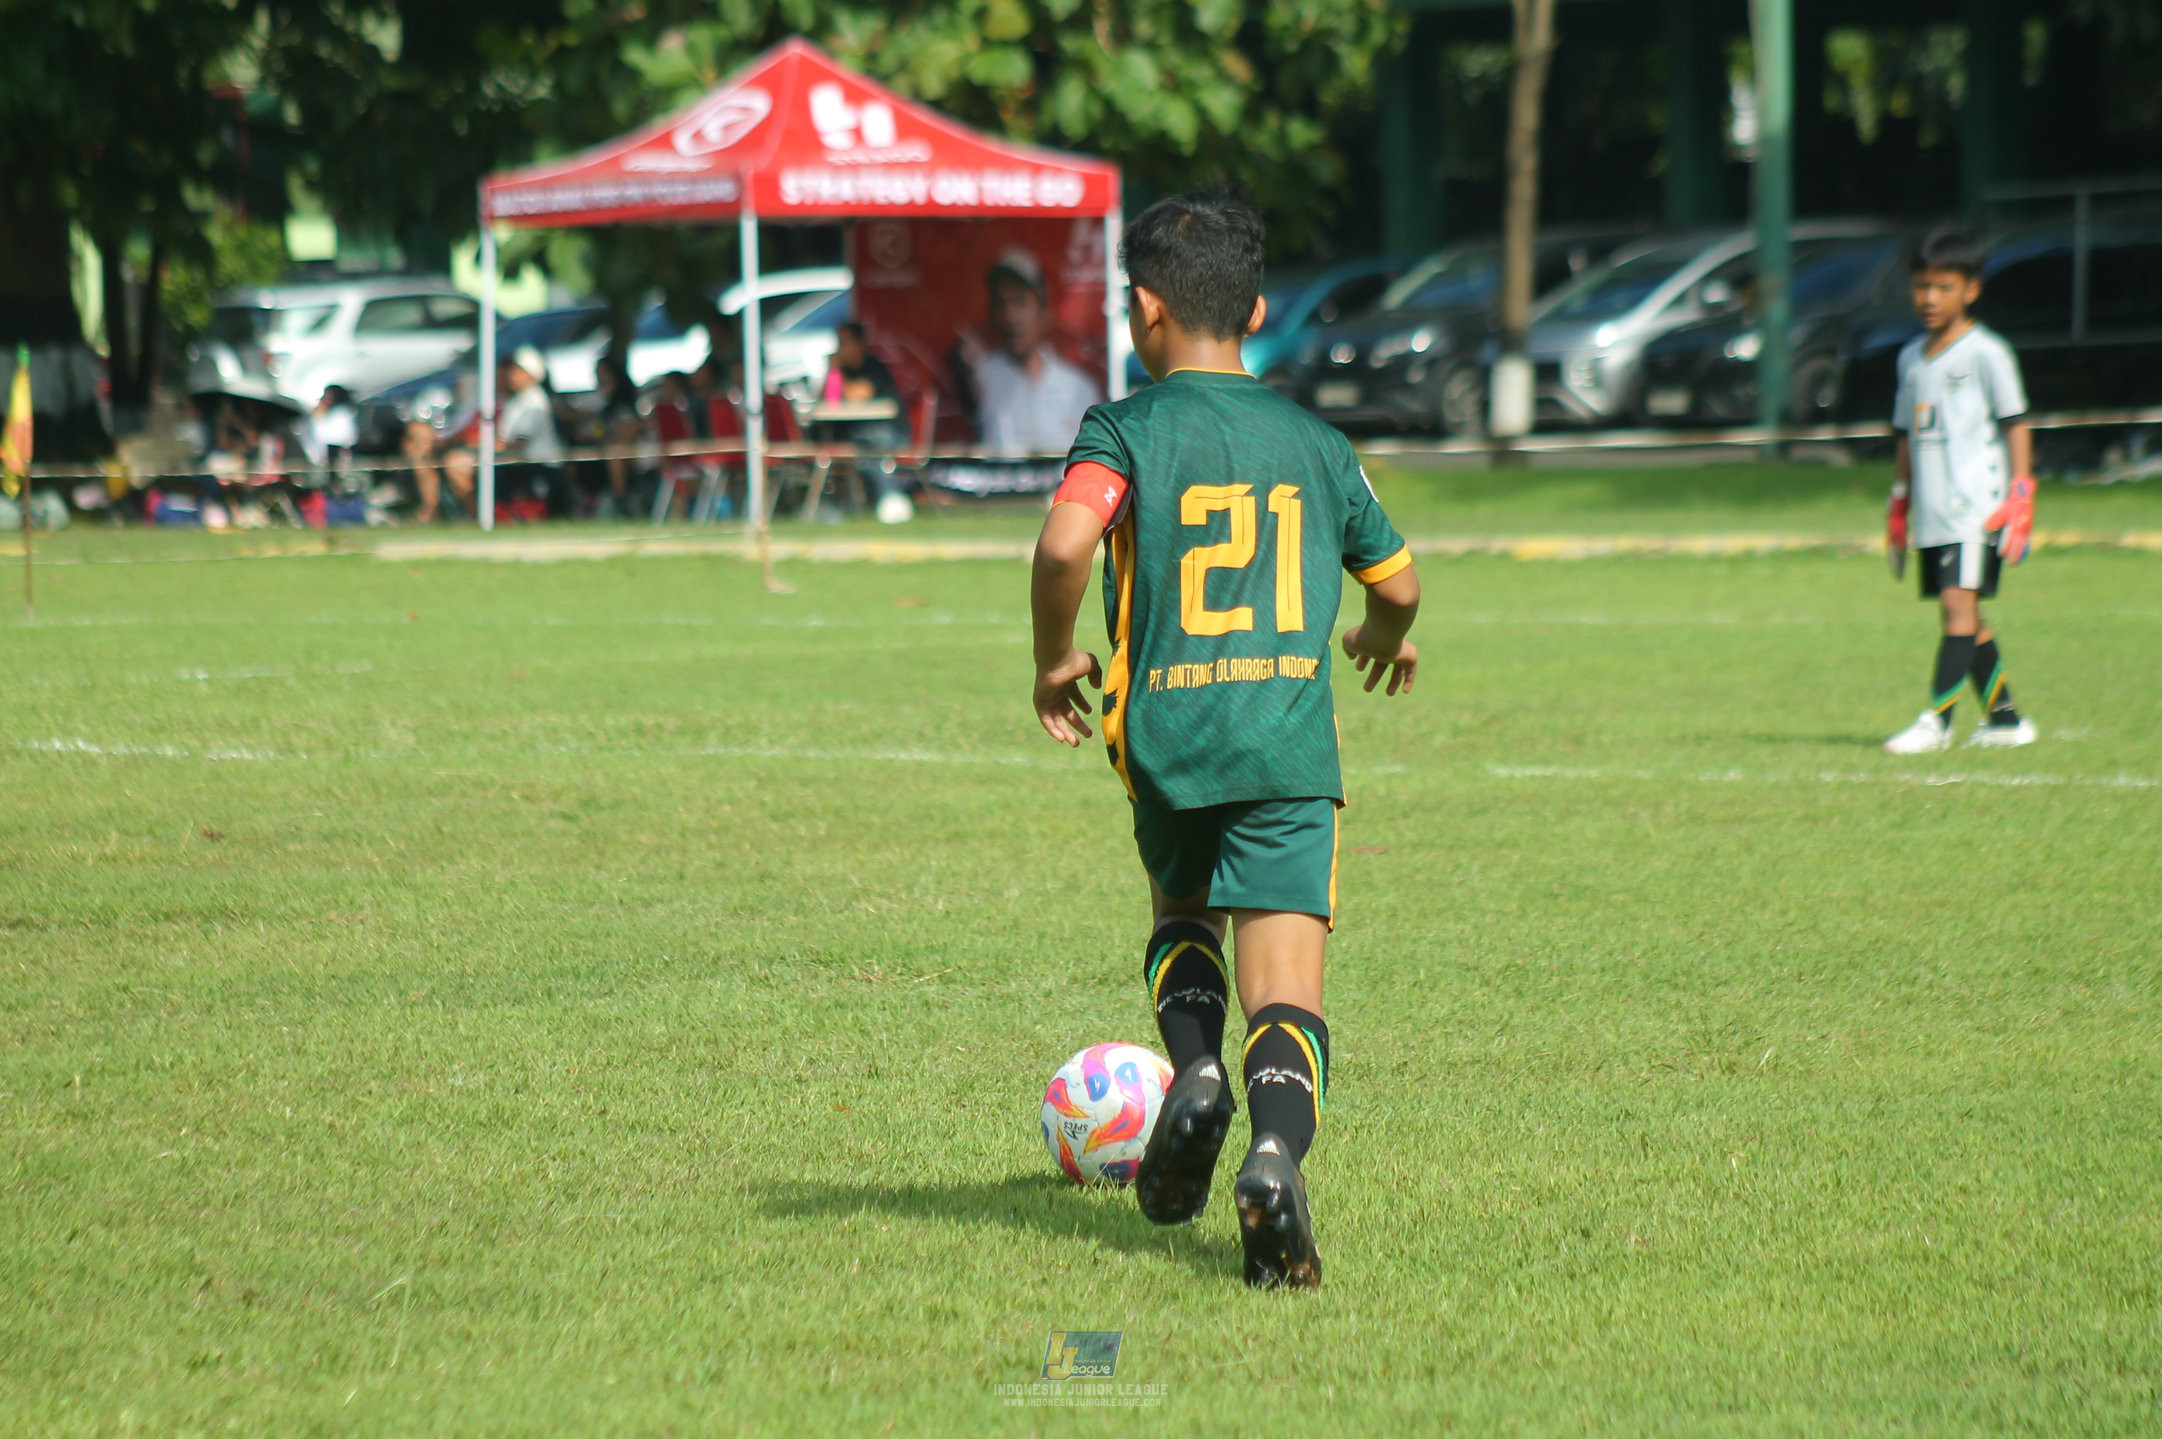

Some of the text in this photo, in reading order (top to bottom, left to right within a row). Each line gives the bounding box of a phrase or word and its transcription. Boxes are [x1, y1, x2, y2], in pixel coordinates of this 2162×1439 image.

[1180, 483, 1305, 637] 21
[1149, 668, 1163, 693] PT.
[1167, 663, 1214, 690] BINTANG
[1216, 658, 1274, 683] OLAHRAGA
[1262, 1075, 1286, 1085] FA
